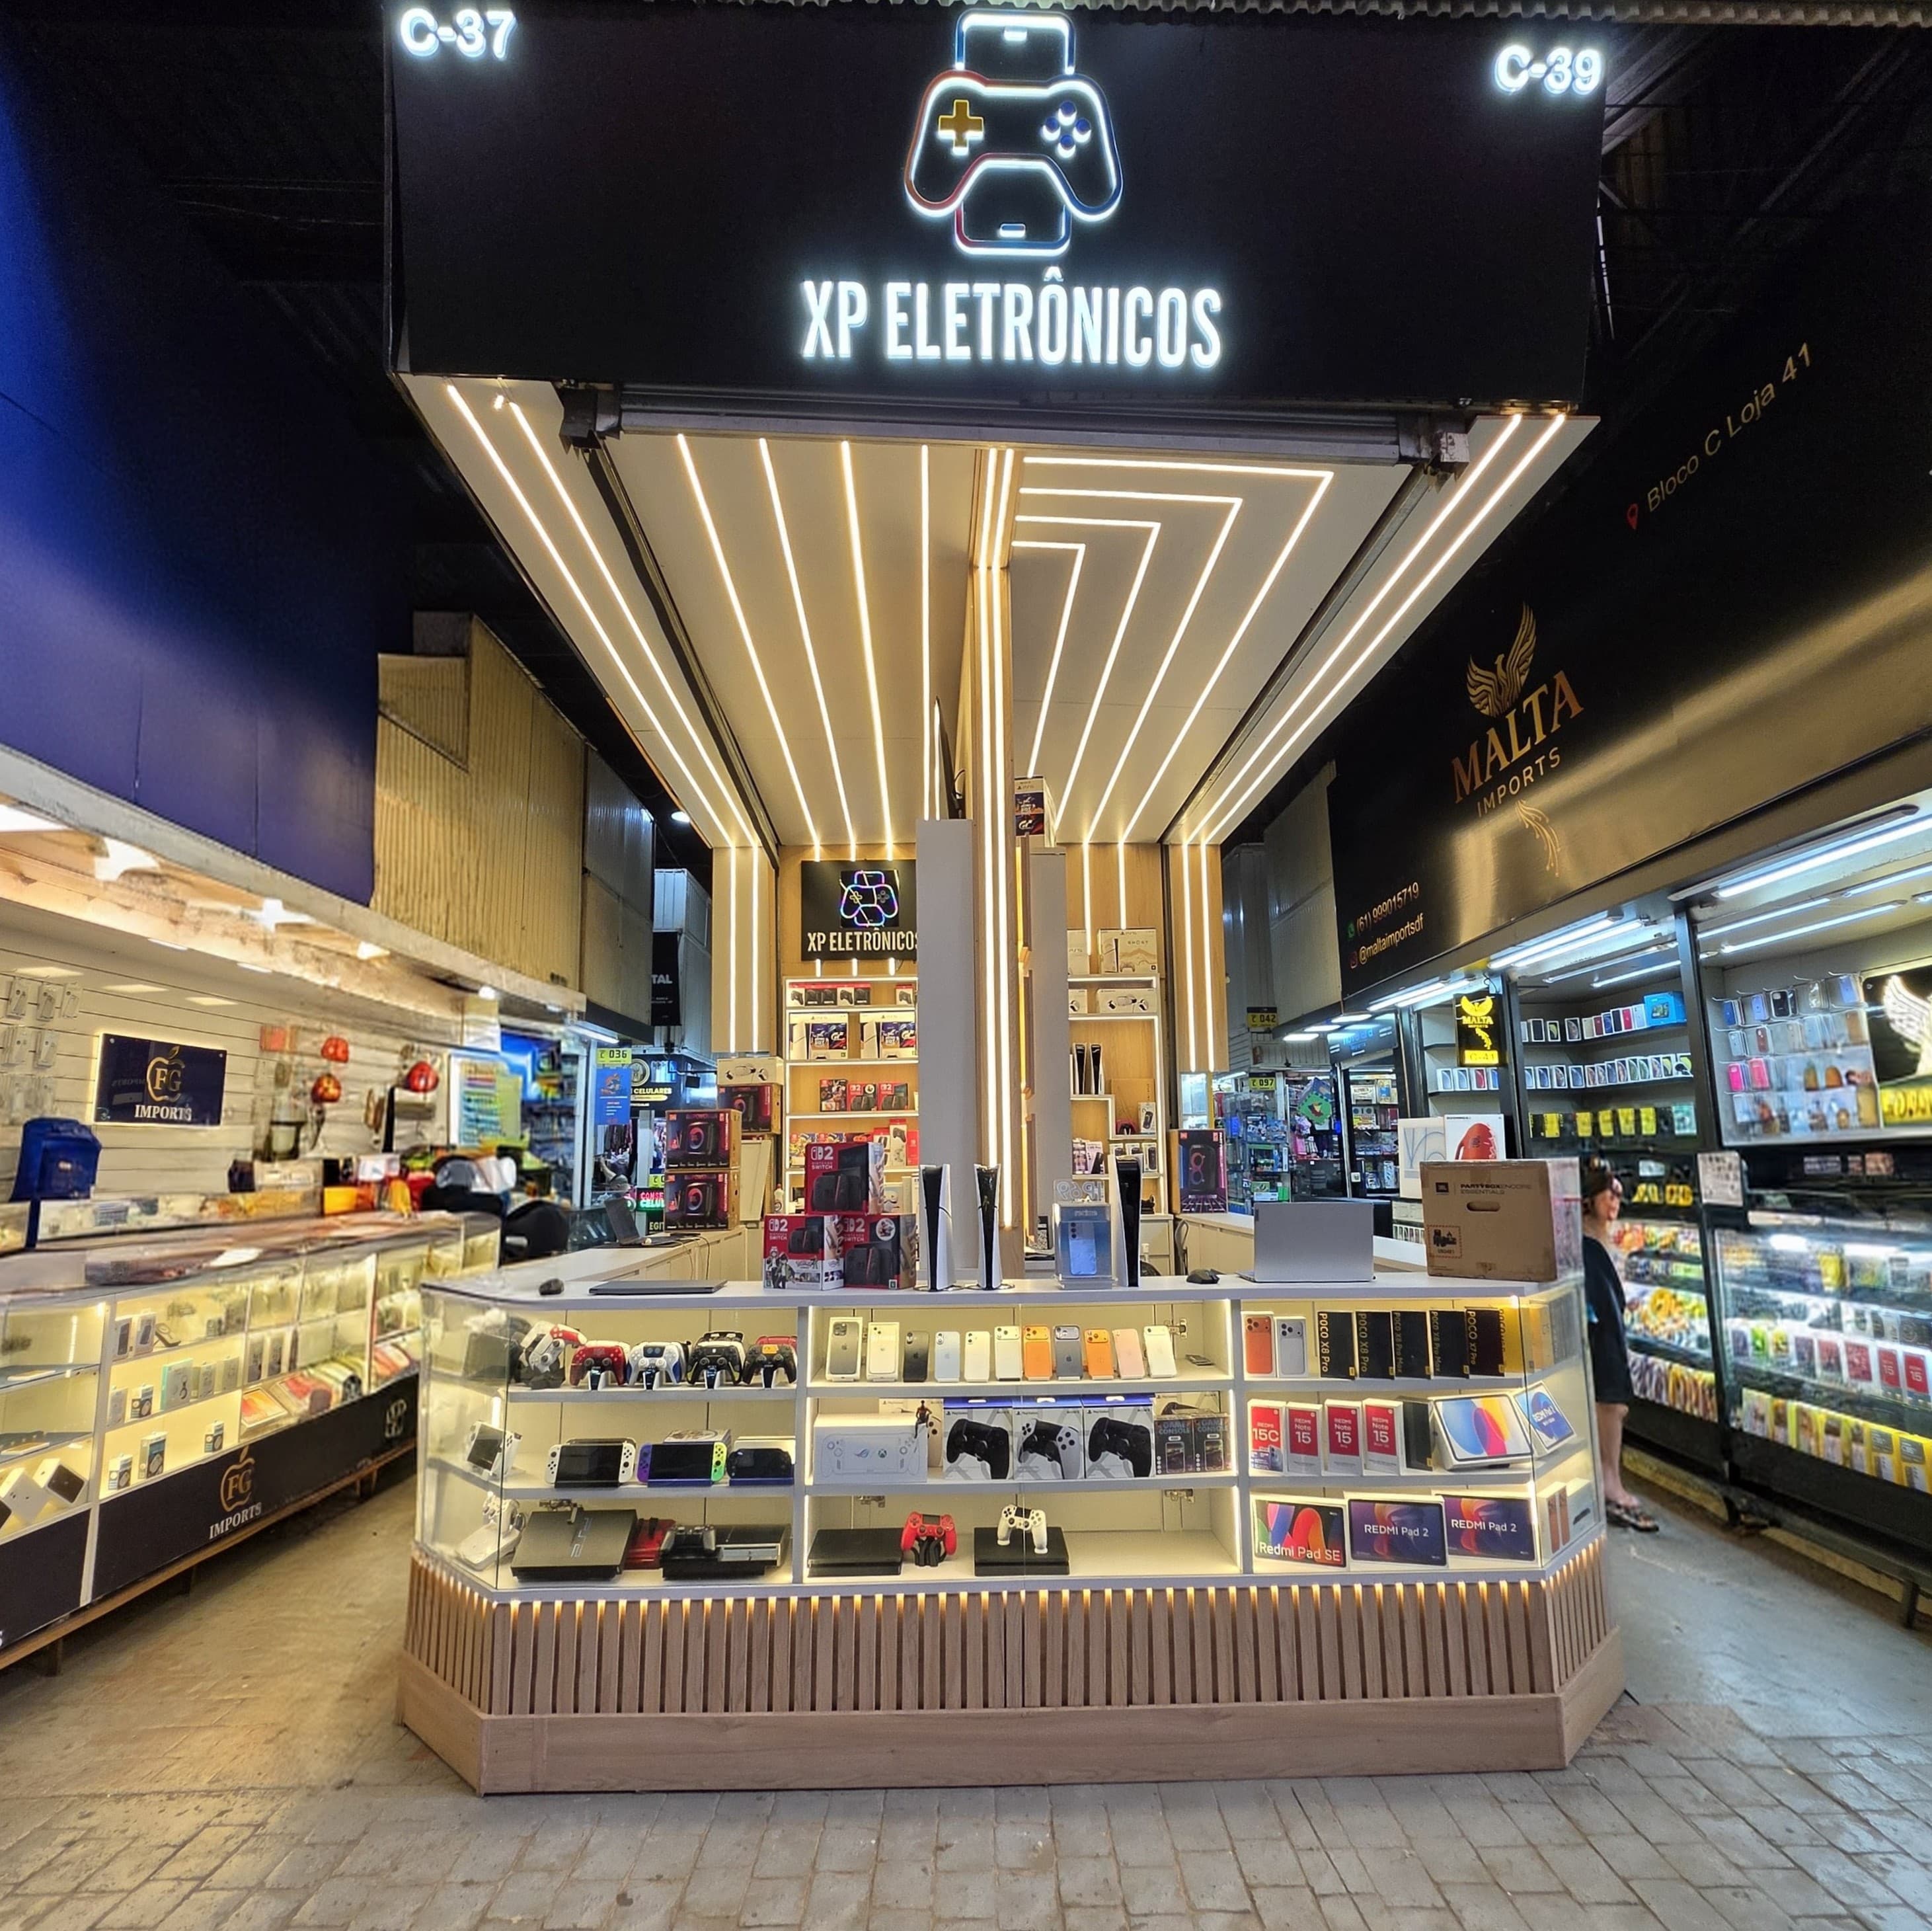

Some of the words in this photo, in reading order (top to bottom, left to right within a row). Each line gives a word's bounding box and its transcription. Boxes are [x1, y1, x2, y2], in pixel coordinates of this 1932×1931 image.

[401, 8, 516, 59] C-37
[1494, 44, 1602, 95] C-39
[802, 280, 867, 358] XP
[886, 266, 1222, 368] ELETRÔNICOS
[1647, 455, 1699, 512] Bloco
[1705, 429, 1721, 456] C
[1726, 383, 1775, 438] Loja
[1451, 670, 1584, 804] MALTA
[1477, 746, 1561, 818] IMPORTS
[1356, 911, 1372, 936] (61)
[1373, 881, 1420, 924] 999015719
[807, 931, 826, 952] XP
[1359, 912, 1424, 965] @maltaimportsdf
[650, 974, 673, 984] TAL
[1259, 1014, 1276, 1023] 042
[1462, 1015, 1494, 1025] MALTA
[609, 1049, 627, 1058] 036
[153, 1067, 182, 1092] FG
[1258, 1078, 1274, 1087] 097
[134, 1104, 192, 1122] IMPORTS
[1319, 1312, 1329, 1339] POCO
[1358, 1313, 1368, 1339] POCO
[1467, 1311, 1478, 1339] POCO
[1321, 1341, 1330, 1354] X8
[1360, 1341, 1369, 1354] X8
[1322, 1356, 1331, 1372] Pro
[1361, 1356, 1370, 1372] Pro
[1883, 1364, 1895, 1376] 15
[1910, 1370, 1923, 1382] 15
[1253, 1428, 1280, 1442] 15C
[1295, 1431, 1312, 1444] 15
[1335, 1431, 1352, 1444] 15
[1373, 1430, 1389, 1443] 15
[227, 1468, 252, 1501] FG
[209, 1502, 262, 1540] IMPORTS
[1451, 1519, 1486, 1530] REDMI
[1488, 1521, 1507, 1532] Pad
[1510, 1523, 1518, 1532] 2
[1364, 1524, 1398, 1536] REDMI
[1401, 1526, 1420, 1537] Pad
[1422, 1528, 1429, 1537] 2
[1259, 1542, 1295, 1557] Redmi
[1297, 1546, 1321, 1559] Pad
[1325, 1549, 1341, 1561] SE
